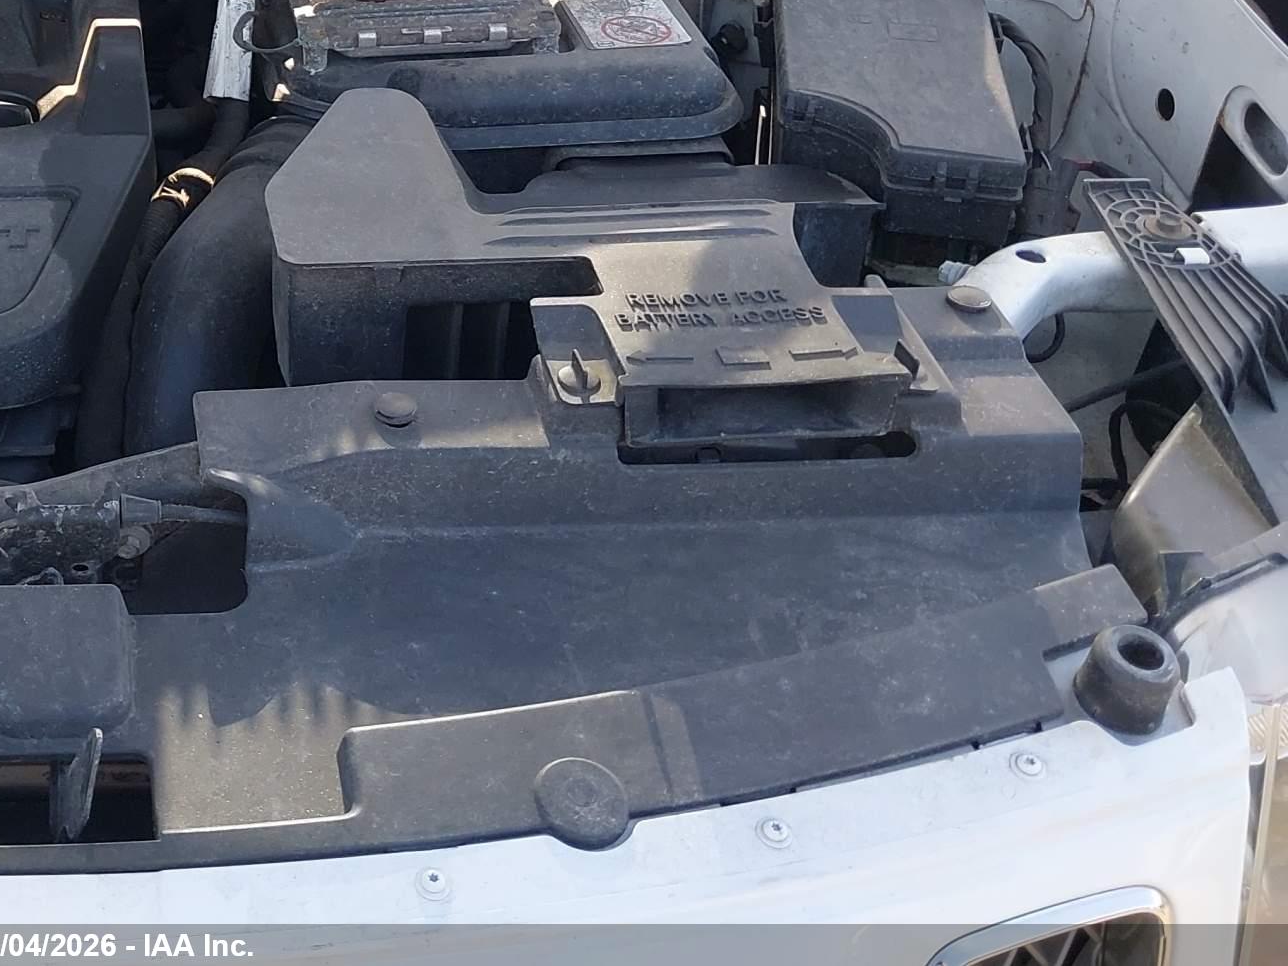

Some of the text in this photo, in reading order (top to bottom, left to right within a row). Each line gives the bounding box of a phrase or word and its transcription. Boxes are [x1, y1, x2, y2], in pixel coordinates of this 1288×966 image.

[624, 289, 788, 312] REMOVE FOR
[613, 305, 827, 332] BATTERY ACCESS
